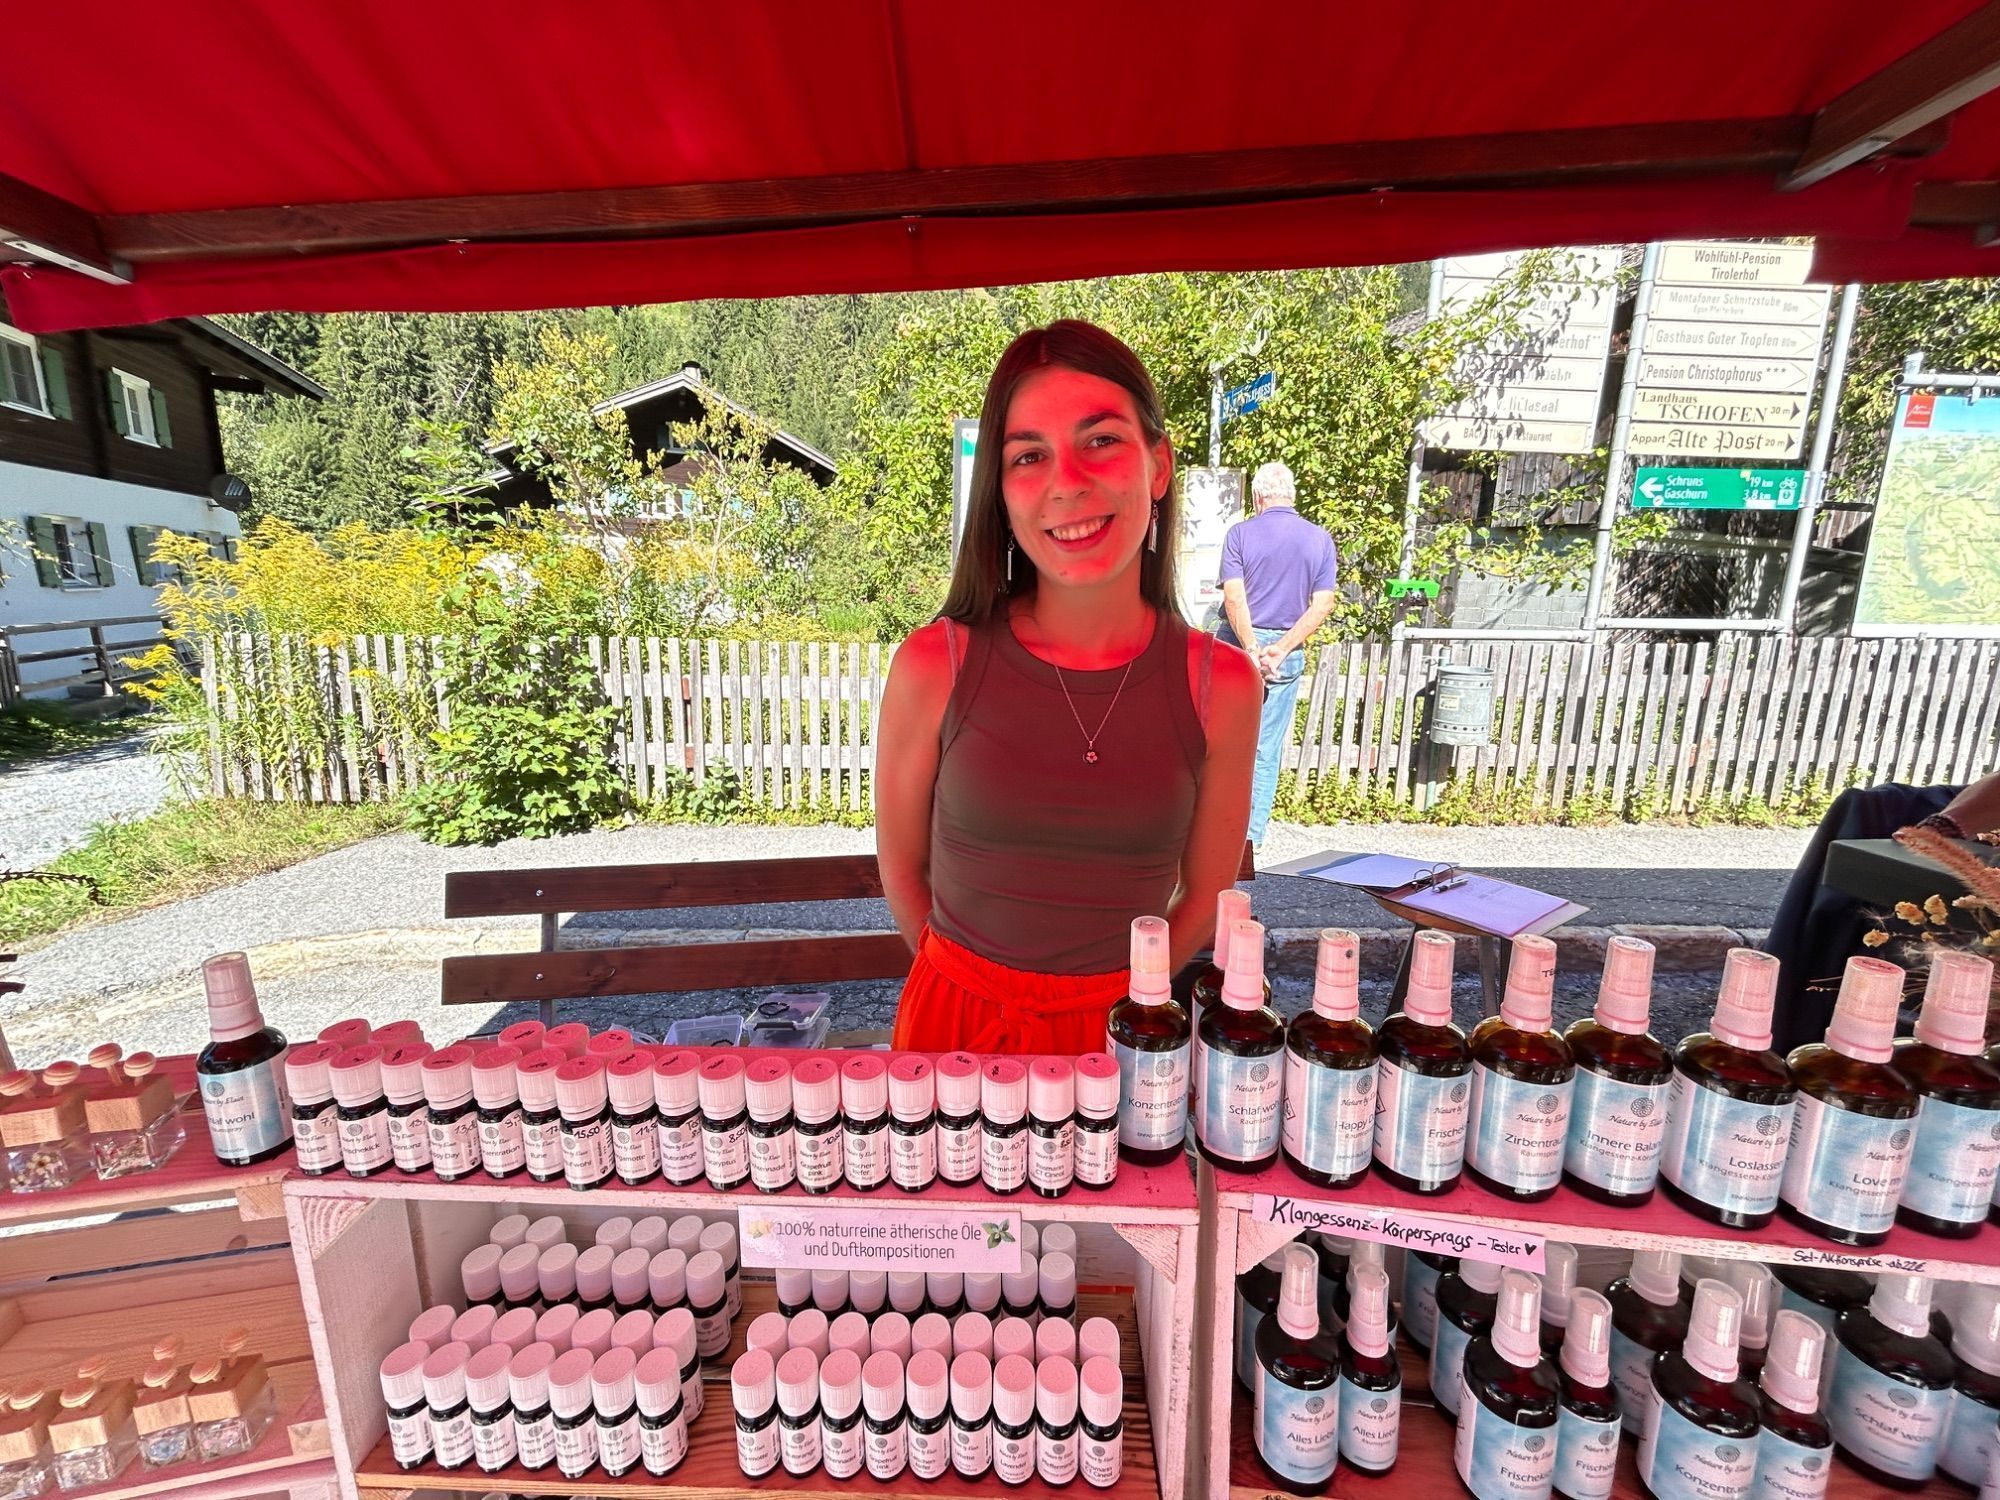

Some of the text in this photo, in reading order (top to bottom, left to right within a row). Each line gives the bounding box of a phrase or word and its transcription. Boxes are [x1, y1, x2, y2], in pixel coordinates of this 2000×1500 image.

[1695, 250, 1781, 264] Wohlfühl-Pension
[1712, 267, 1759, 280] Tirolerhof
[1670, 292, 1720, 304] Montafoner
[1723, 294, 1780, 306] Schnitzstube
[1656, 329, 1703, 344] Gasthaus
[1708, 332, 1735, 345] Guter
[1740, 332, 1778, 348] Tropfen
[1647, 364, 1762, 384] Pension Christophorus
[1642, 392, 1697, 403] Landhaus
[1659, 403, 1767, 422] TSCHOFEN
[1632, 434, 1665, 445] Appart
[1667, 429, 1707, 448] Alte
[1714, 430, 1763, 452] Post
[1667, 475, 1703, 486] Schruns
[1665, 489, 1708, 500] Gaschurn
[1229, 1105, 1261, 1116] Schlaf
[225, 1112, 255, 1125] wohl
[1516, 1114, 1543, 1124] Nature
[1608, 1116, 1637, 1127] Nature
[574, 1126, 600, 1139] 15,50
[1335, 1121, 1367, 1131] Happy
[1587, 1130, 1631, 1151] Innere
[1731, 1134, 1764, 1146] Nature
[800, 1161, 832, 1170] Grapefruit
[1853, 1174, 1887, 1186] Love
[777, 1221, 982, 1241] 100% naturreine ätherische Öle
[804, 1241, 955, 1261] und Duftkompositionen
[1854, 1407, 1899, 1435] Schlaf
[1286, 1431, 1313, 1445] Alles
[1353, 1425, 1376, 1439] Alles
[1001, 1460, 1026, 1468] Lavendel
